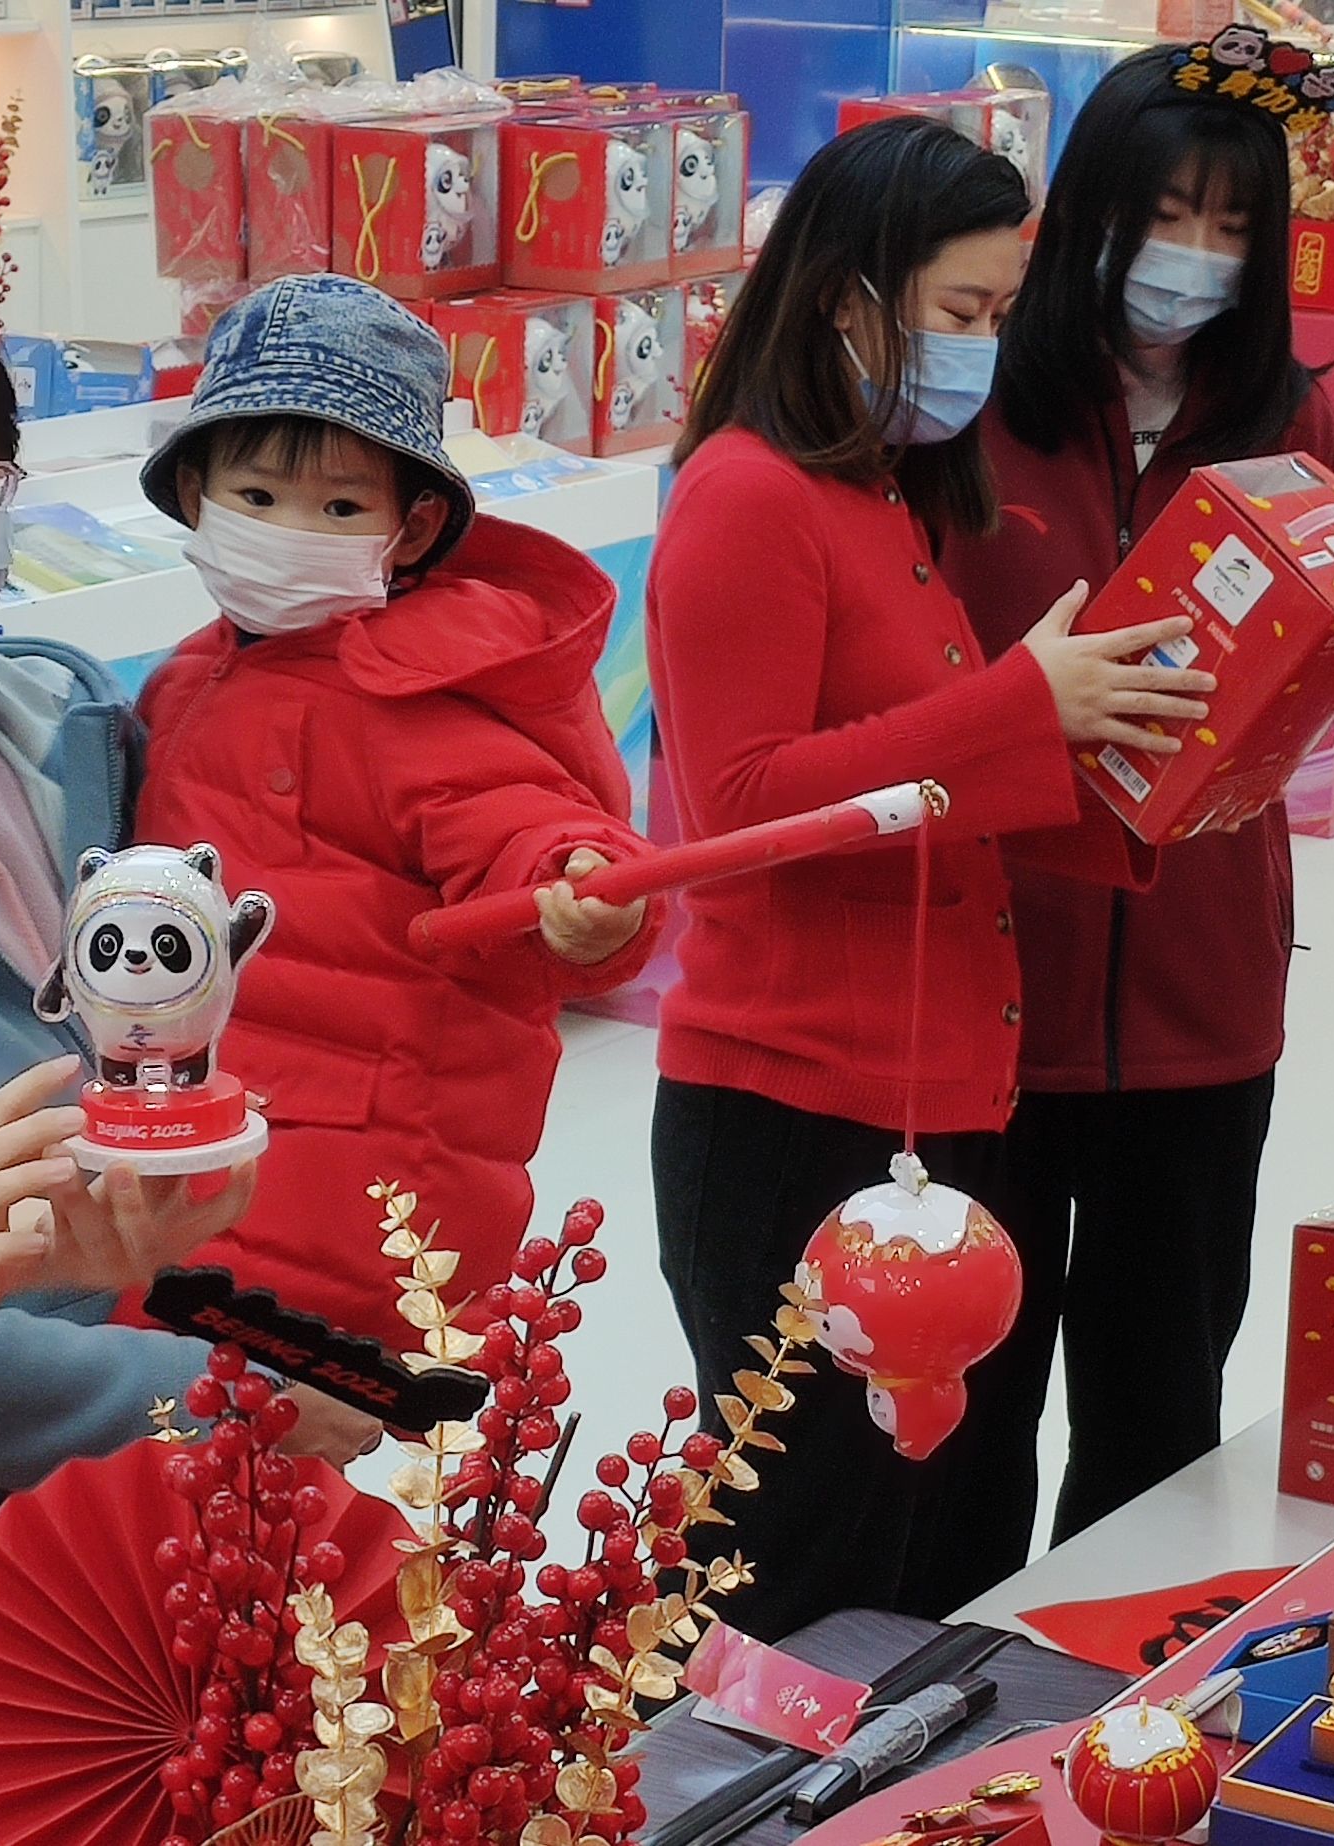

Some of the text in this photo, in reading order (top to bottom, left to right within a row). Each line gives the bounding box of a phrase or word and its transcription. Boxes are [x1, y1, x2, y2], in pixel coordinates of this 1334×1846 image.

[96, 1120, 197, 1141] BEIJING 2022
[190, 1306, 399, 1408] BEIJING 2022
